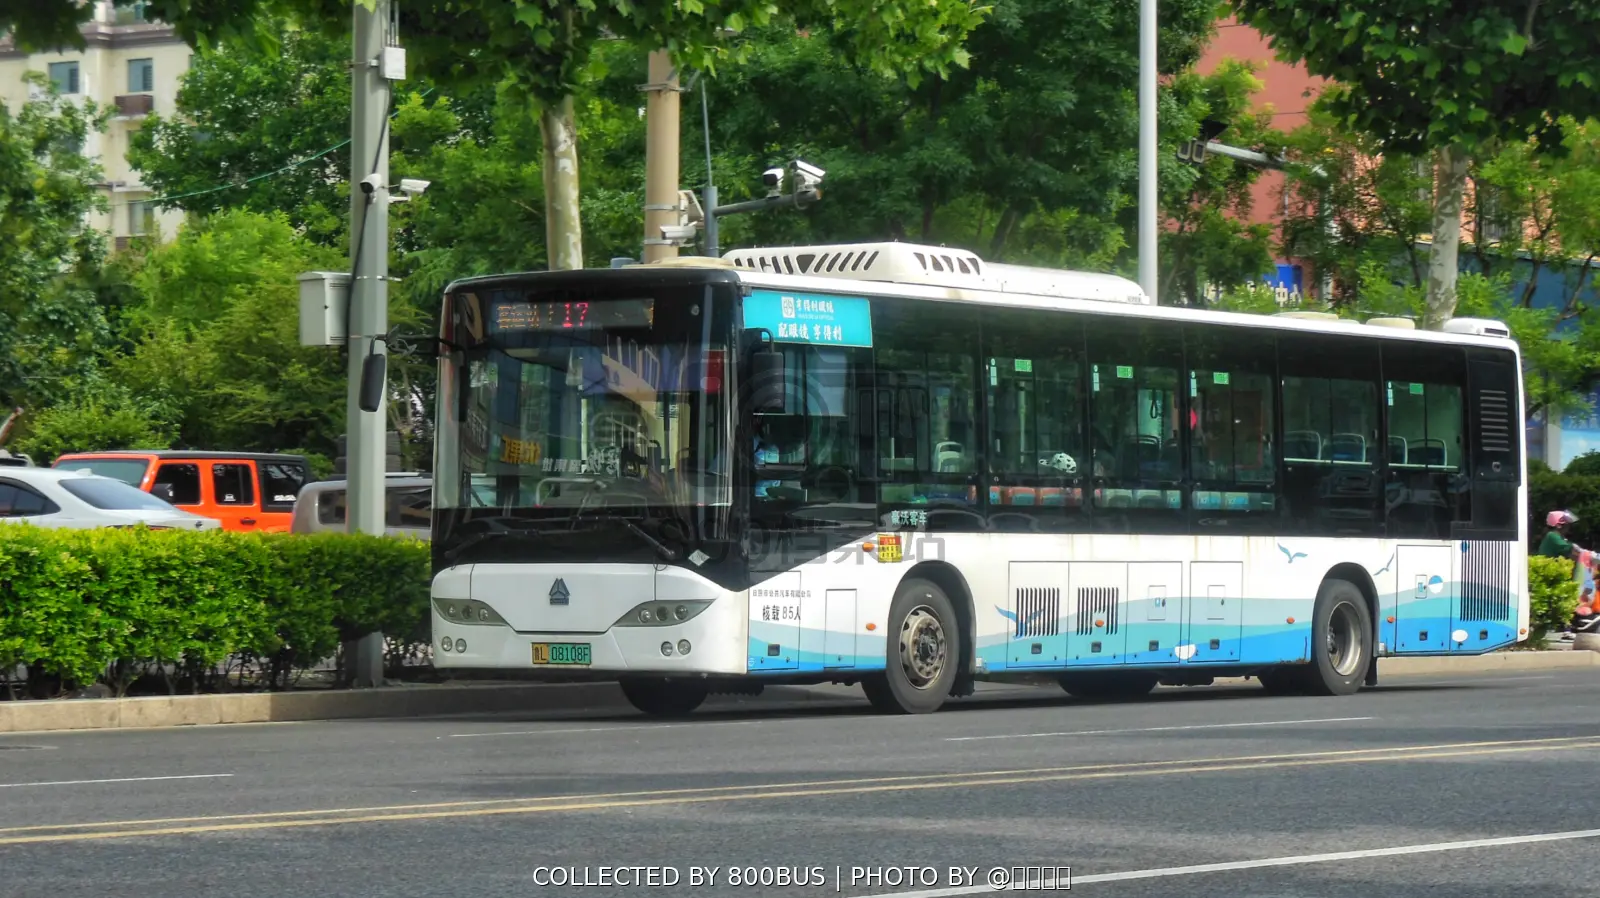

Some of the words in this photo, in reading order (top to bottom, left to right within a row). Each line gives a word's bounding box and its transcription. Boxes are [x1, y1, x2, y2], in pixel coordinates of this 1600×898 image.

[562, 302, 588, 328] 17
[891, 509, 928, 526] 豪沃客车
